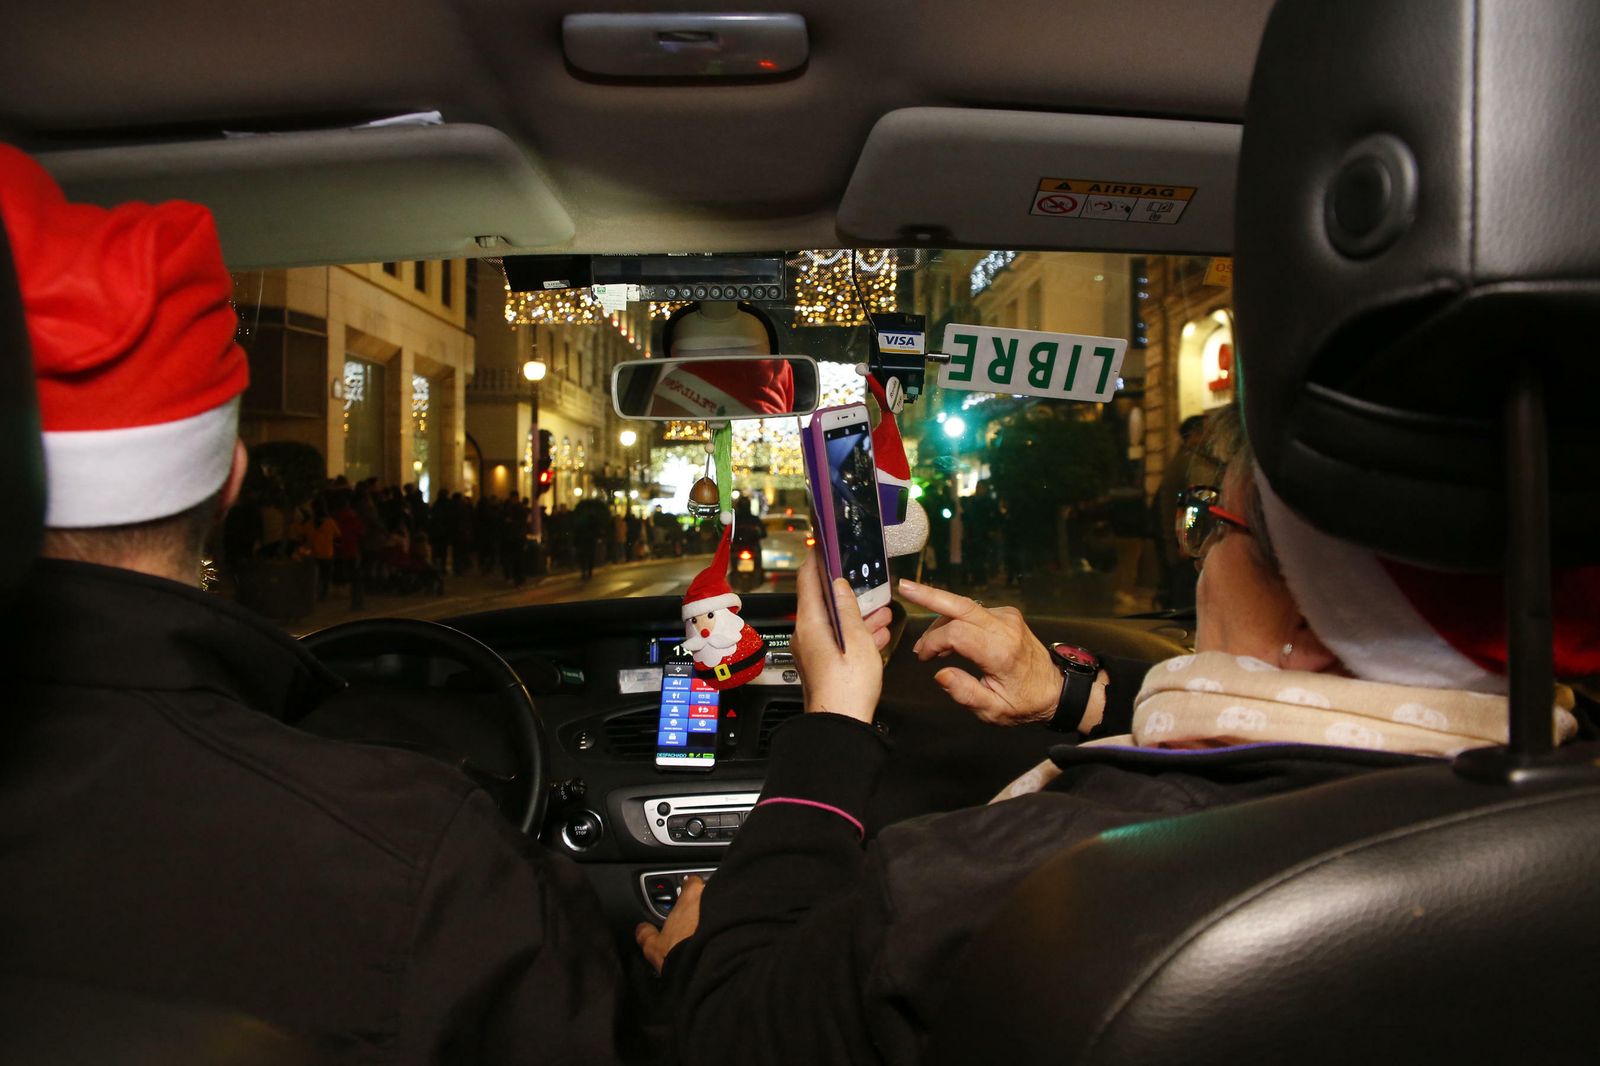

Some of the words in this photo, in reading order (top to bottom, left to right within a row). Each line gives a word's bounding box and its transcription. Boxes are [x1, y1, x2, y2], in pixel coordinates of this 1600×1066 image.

[1088, 183, 1176, 197] AIRBAG
[885, 335, 915, 346] VISA
[948, 334, 1116, 394] LIBRE
